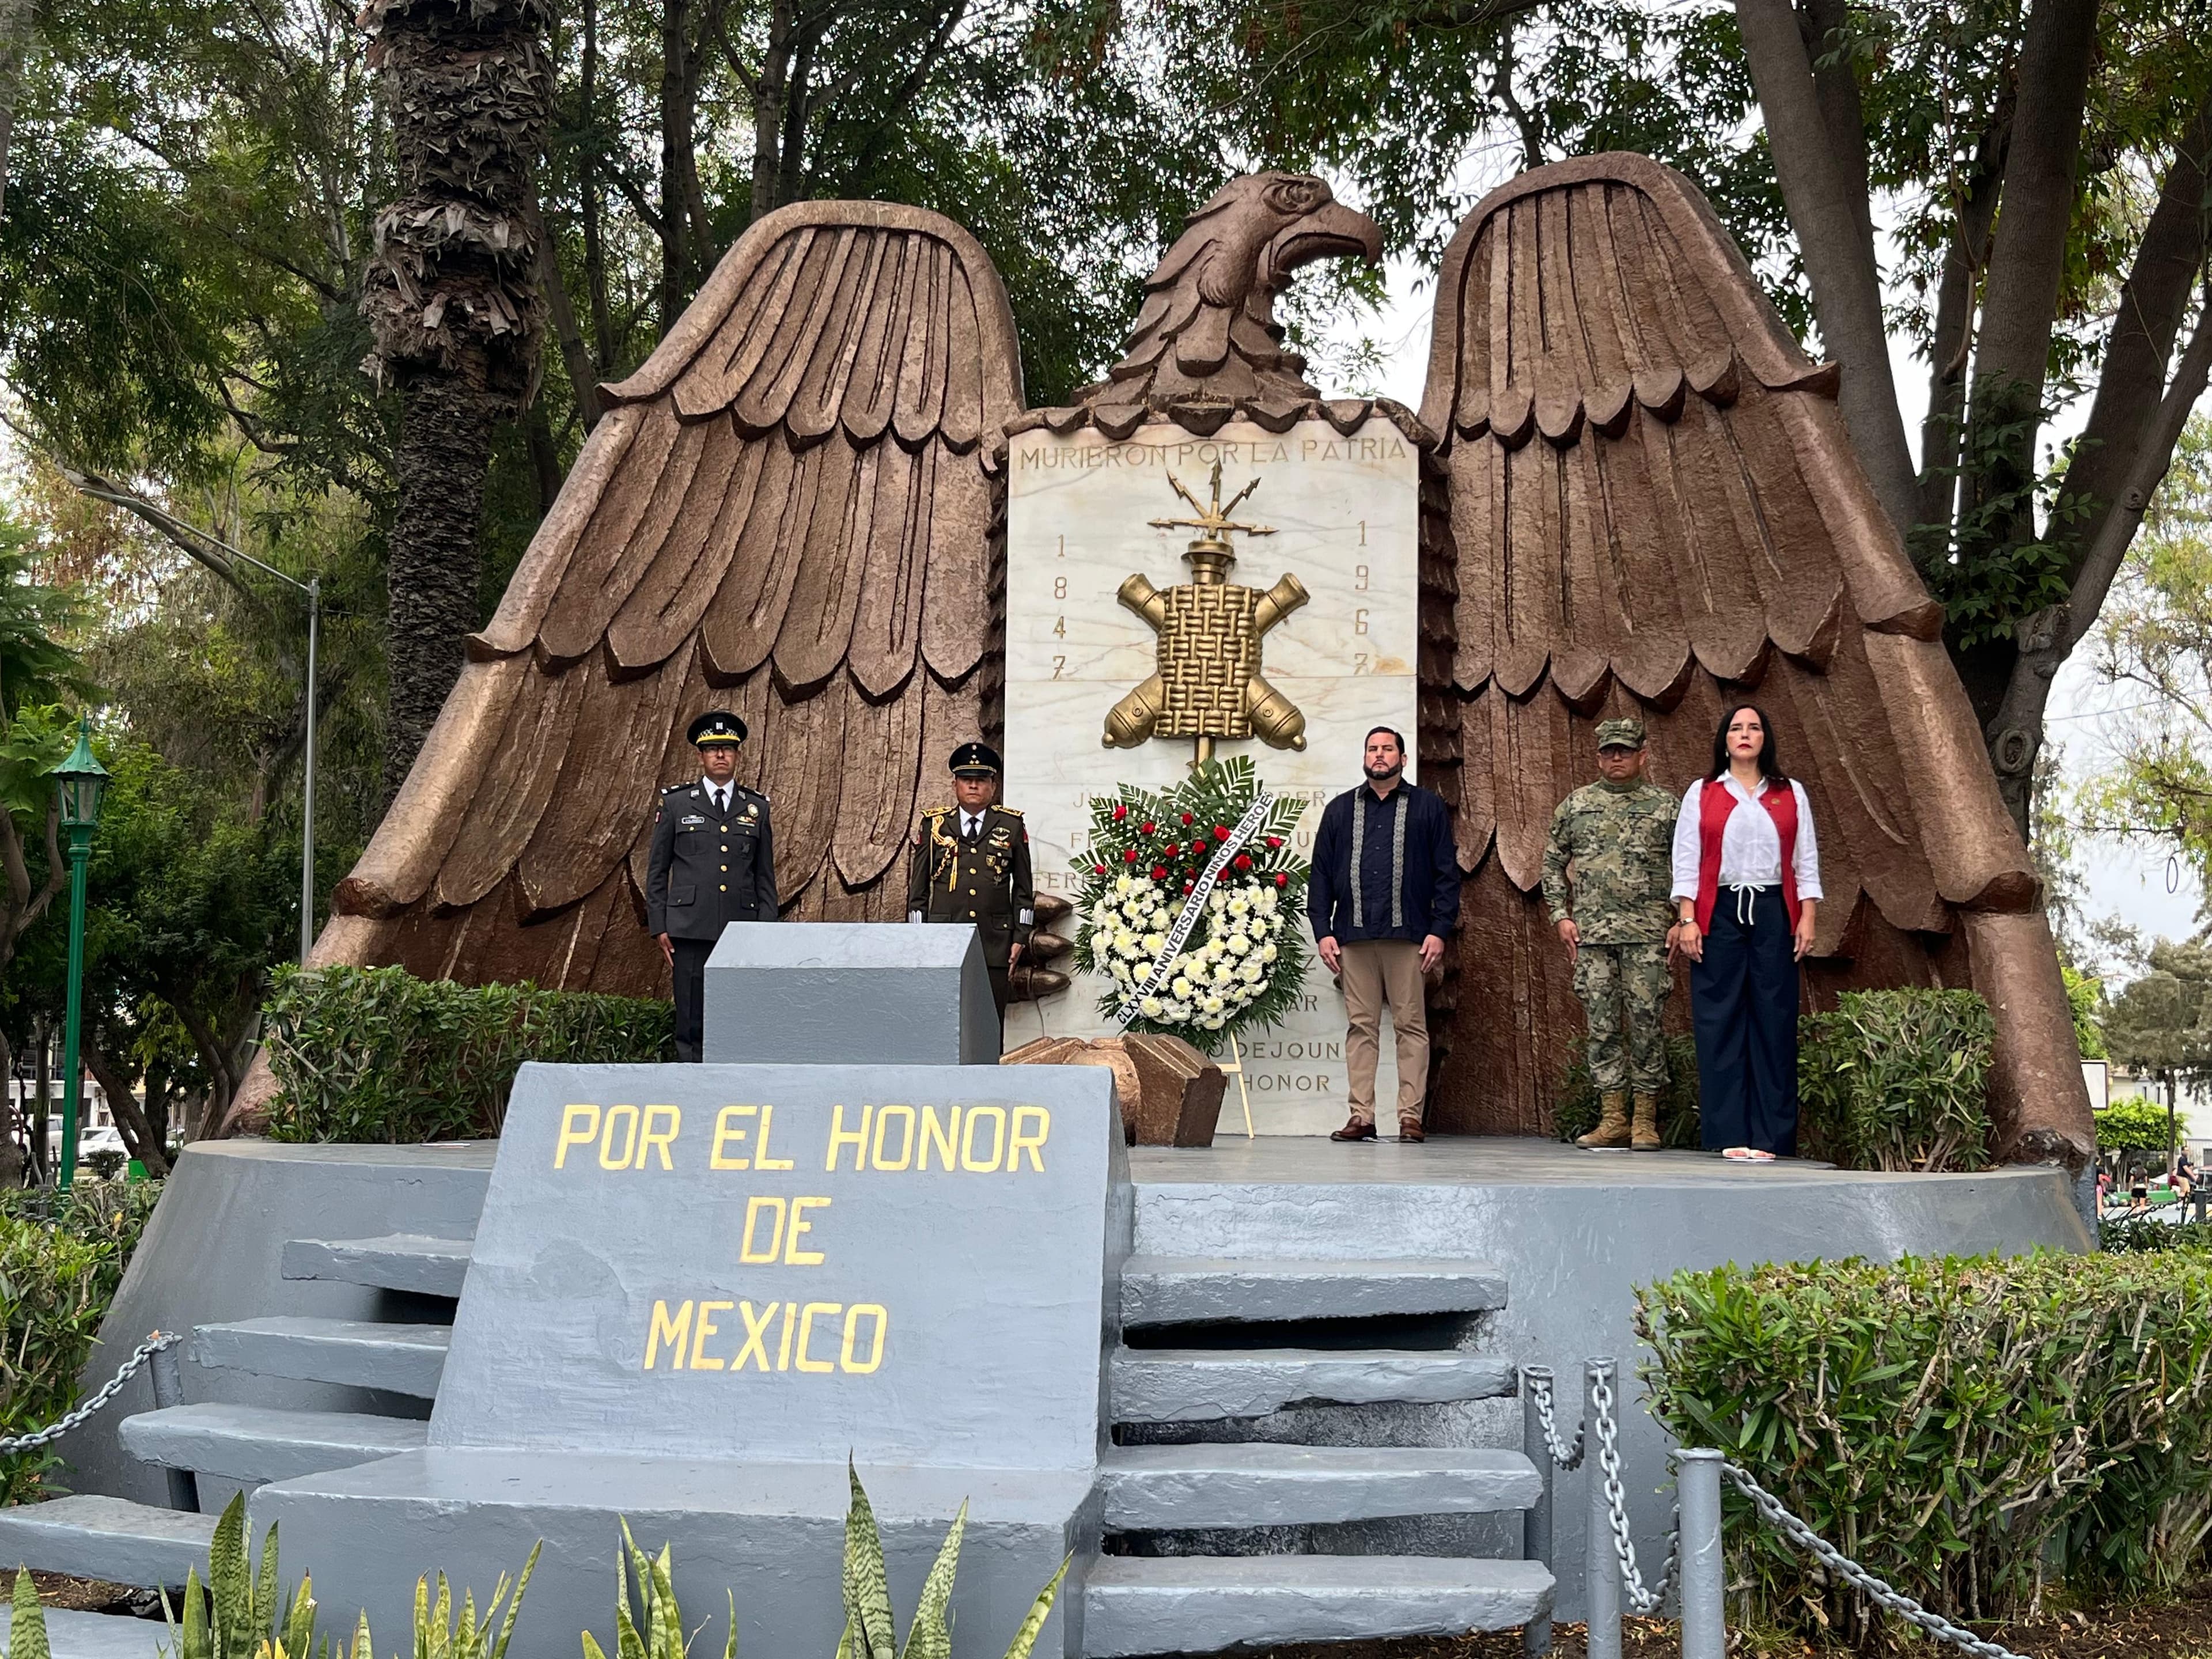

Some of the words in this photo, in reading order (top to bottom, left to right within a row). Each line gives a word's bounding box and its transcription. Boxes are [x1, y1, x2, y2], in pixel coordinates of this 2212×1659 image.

[1020, 445, 1166, 469] MURIERON
[1178, 442, 1238, 467] POR
[1252, 442, 1289, 463] LA
[1302, 438, 1406, 461] PATRIA
[1153, 881, 1209, 979] ANIVERSARIO
[554, 1104, 681, 1170] POR
[710, 1105, 794, 1170] EL
[825, 1105, 1051, 1172] HONOR
[740, 1196, 832, 1265] DE
[644, 1300, 888, 1374] MEXICO
